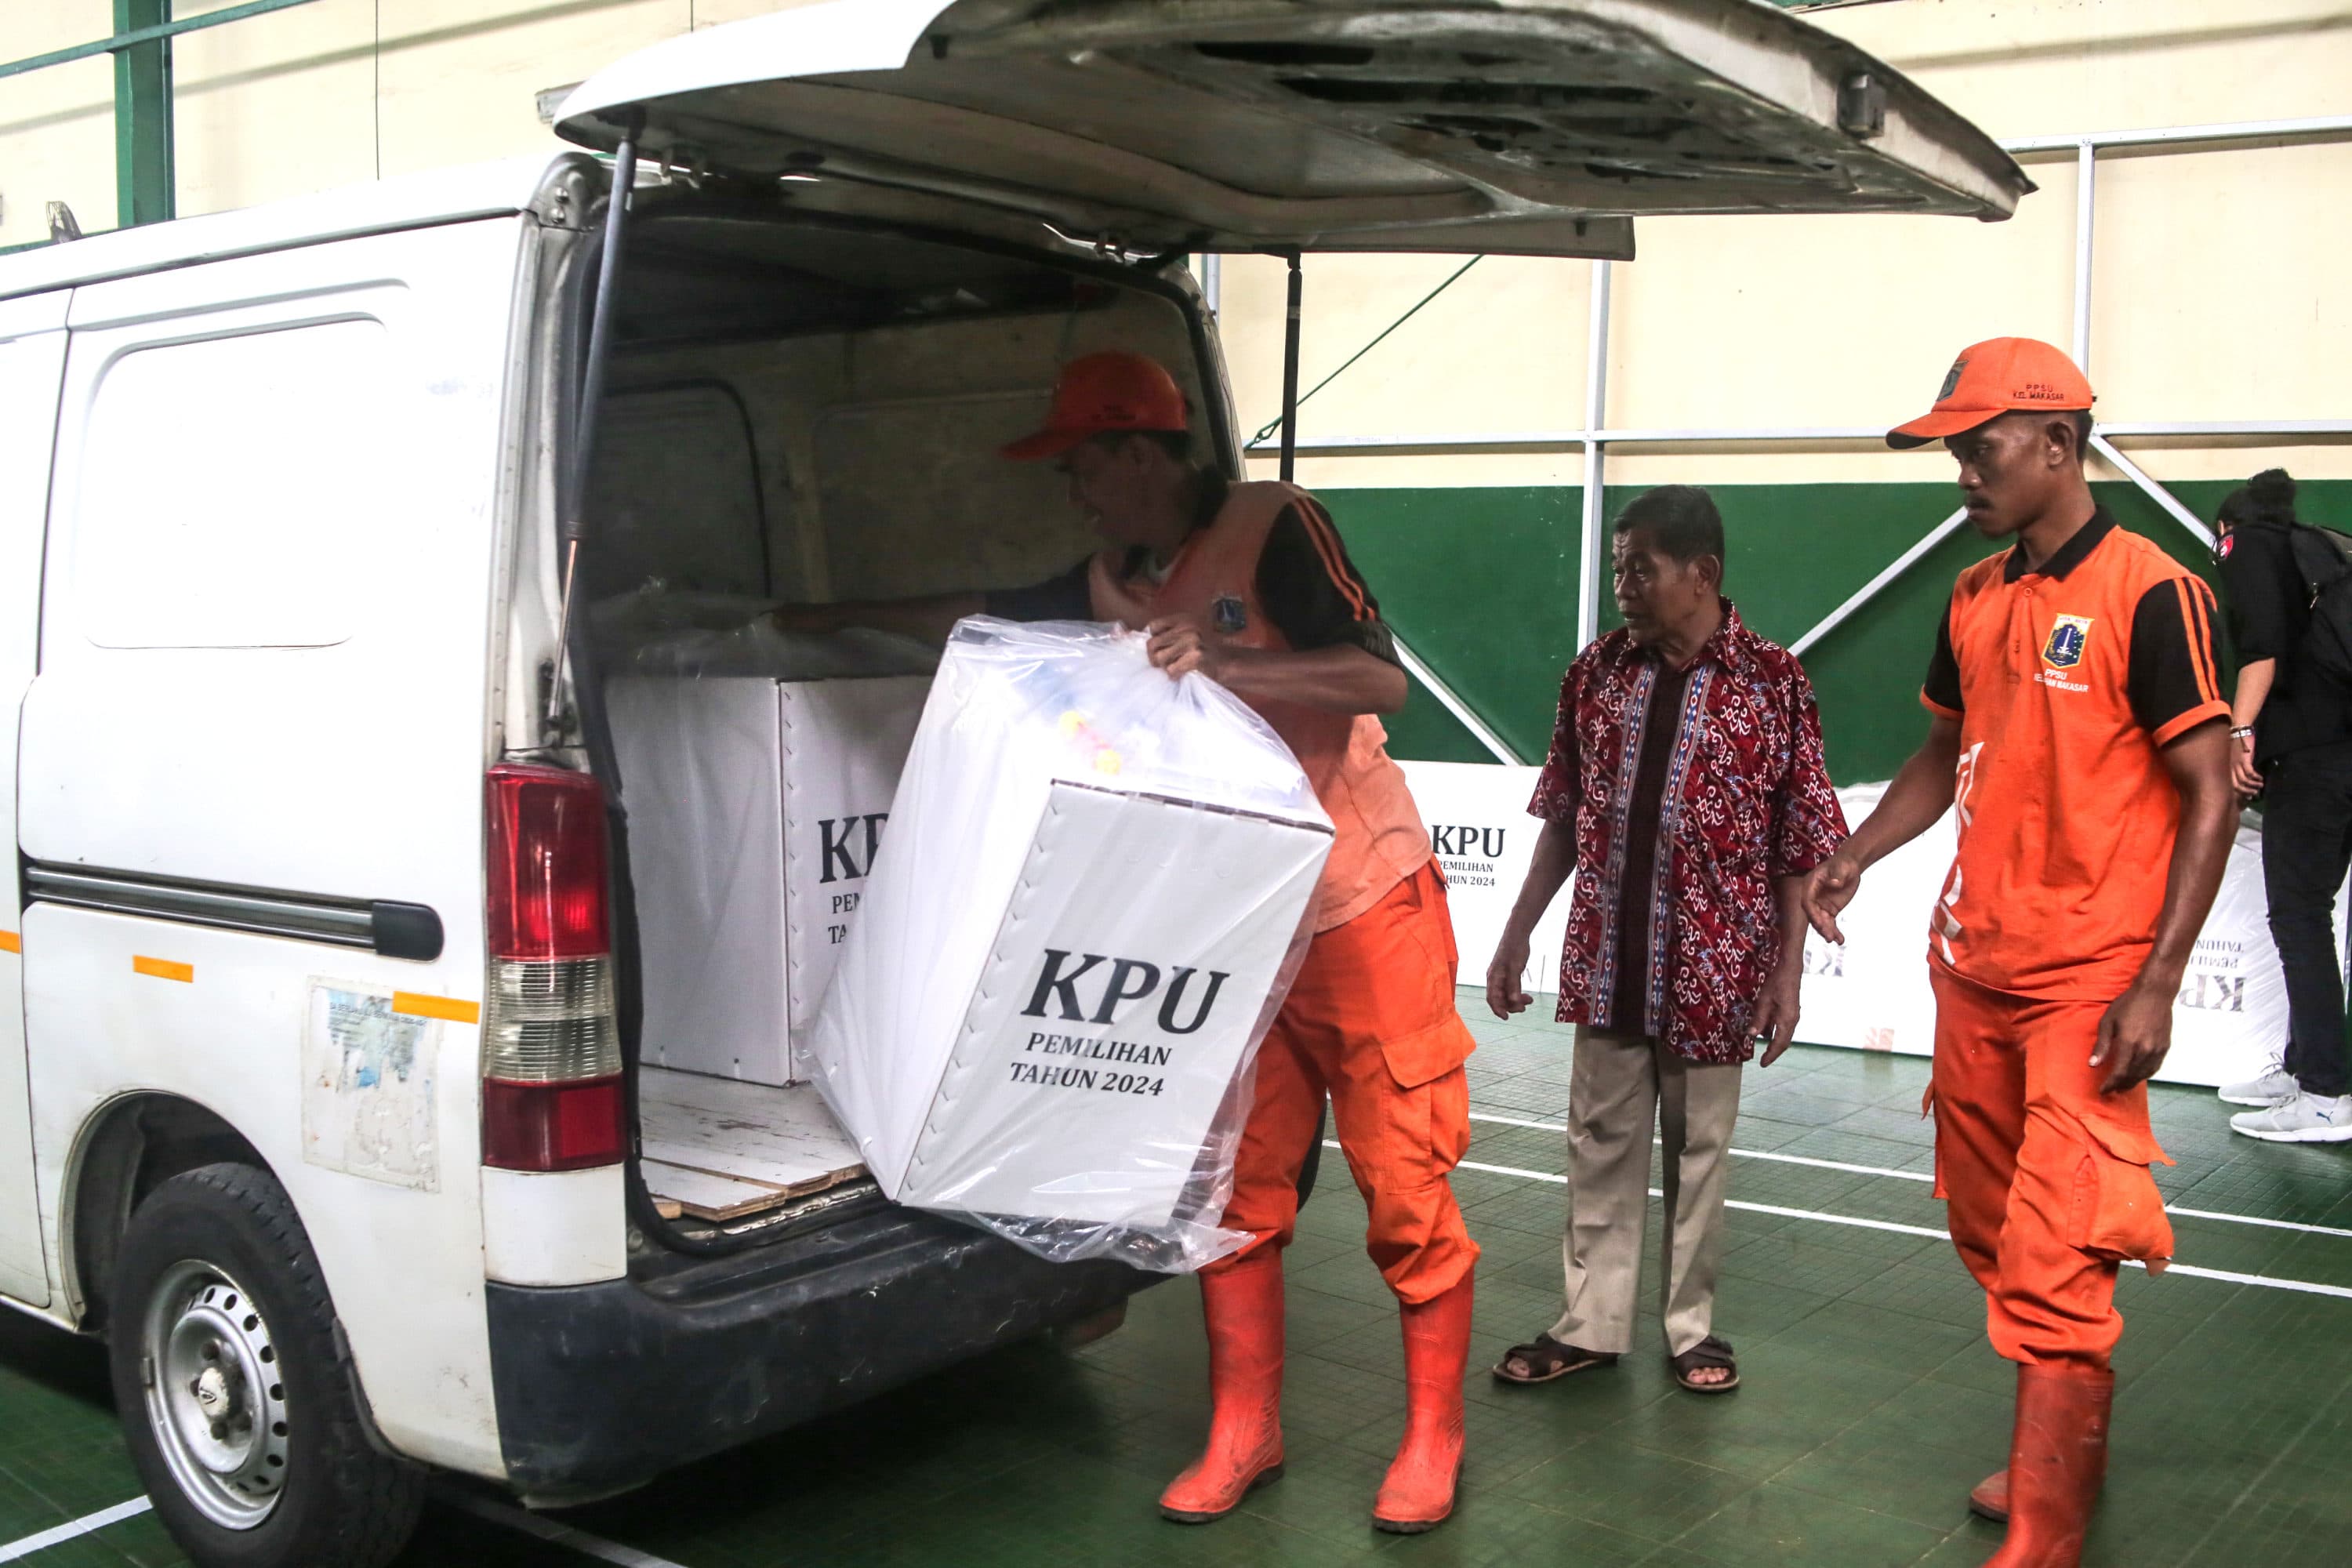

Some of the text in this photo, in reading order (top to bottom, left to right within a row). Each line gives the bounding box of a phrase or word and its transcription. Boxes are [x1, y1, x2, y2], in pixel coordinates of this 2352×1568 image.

[2025, 383, 2053, 393] PPSU
[2029, 391, 2064, 401] MAKASAR
[2045, 668, 2068, 681] PPSU
[2056, 680, 2089, 693] MAKASAR
[1431, 825, 1506, 858] KPU
[1470, 876, 1496, 887] 2024
[1020, 948, 1231, 1035] KPU
[1025, 1032, 1173, 1066] PEMILIHAN
[1010, 1062, 1165, 1097] TAHUN 2024
